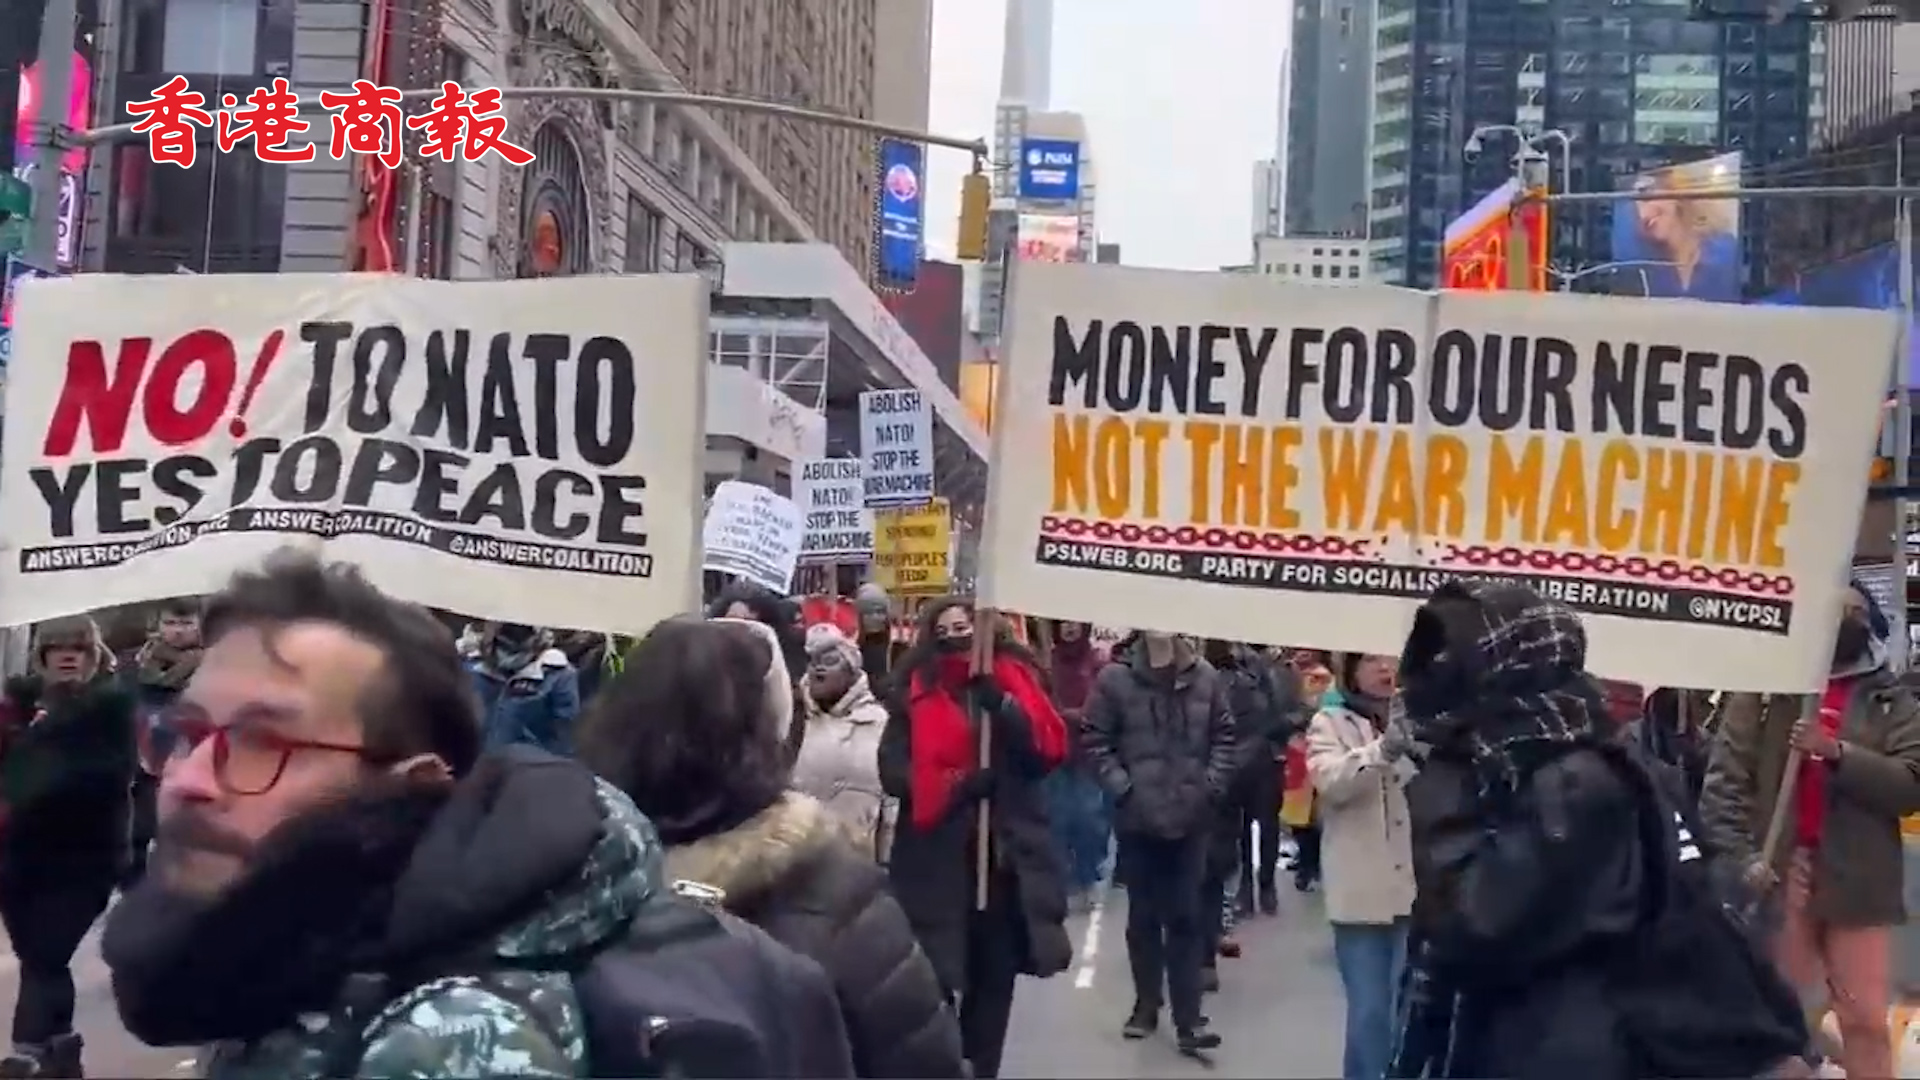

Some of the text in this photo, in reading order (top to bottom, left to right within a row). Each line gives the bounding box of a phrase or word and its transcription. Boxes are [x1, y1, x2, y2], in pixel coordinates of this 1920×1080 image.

[43, 321, 635, 466] NO! TO NATO
[868, 391, 921, 414] ABOLISH
[1049, 315, 1809, 459] MONEY FOR OUR NEEDS
[29, 436, 647, 546] YES TO PEACE
[802, 462, 861, 480] ABOLISH
[872, 449, 920, 471] STOP THE
[1052, 413, 1169, 520] NOT
[1185, 421, 1303, 530] THE
[1318, 426, 1469, 536] WAR
[1484, 433, 1802, 568] MACHINE
[250, 510, 433, 543] ANSWERCOALITION
[450, 535, 650, 576] @ANSWERCOALITION
[806, 512, 835, 529] STOP
[836, 510, 860, 527] THE
[1043, 543, 1184, 573] PSLWEB.ORG
[1201, 556, 1275, 581] PARTY
[1281, 563, 1327, 585] FOR
[1527, 579, 1669, 613] IBERATION
[1688, 596, 1784, 627] @NYCPSL
